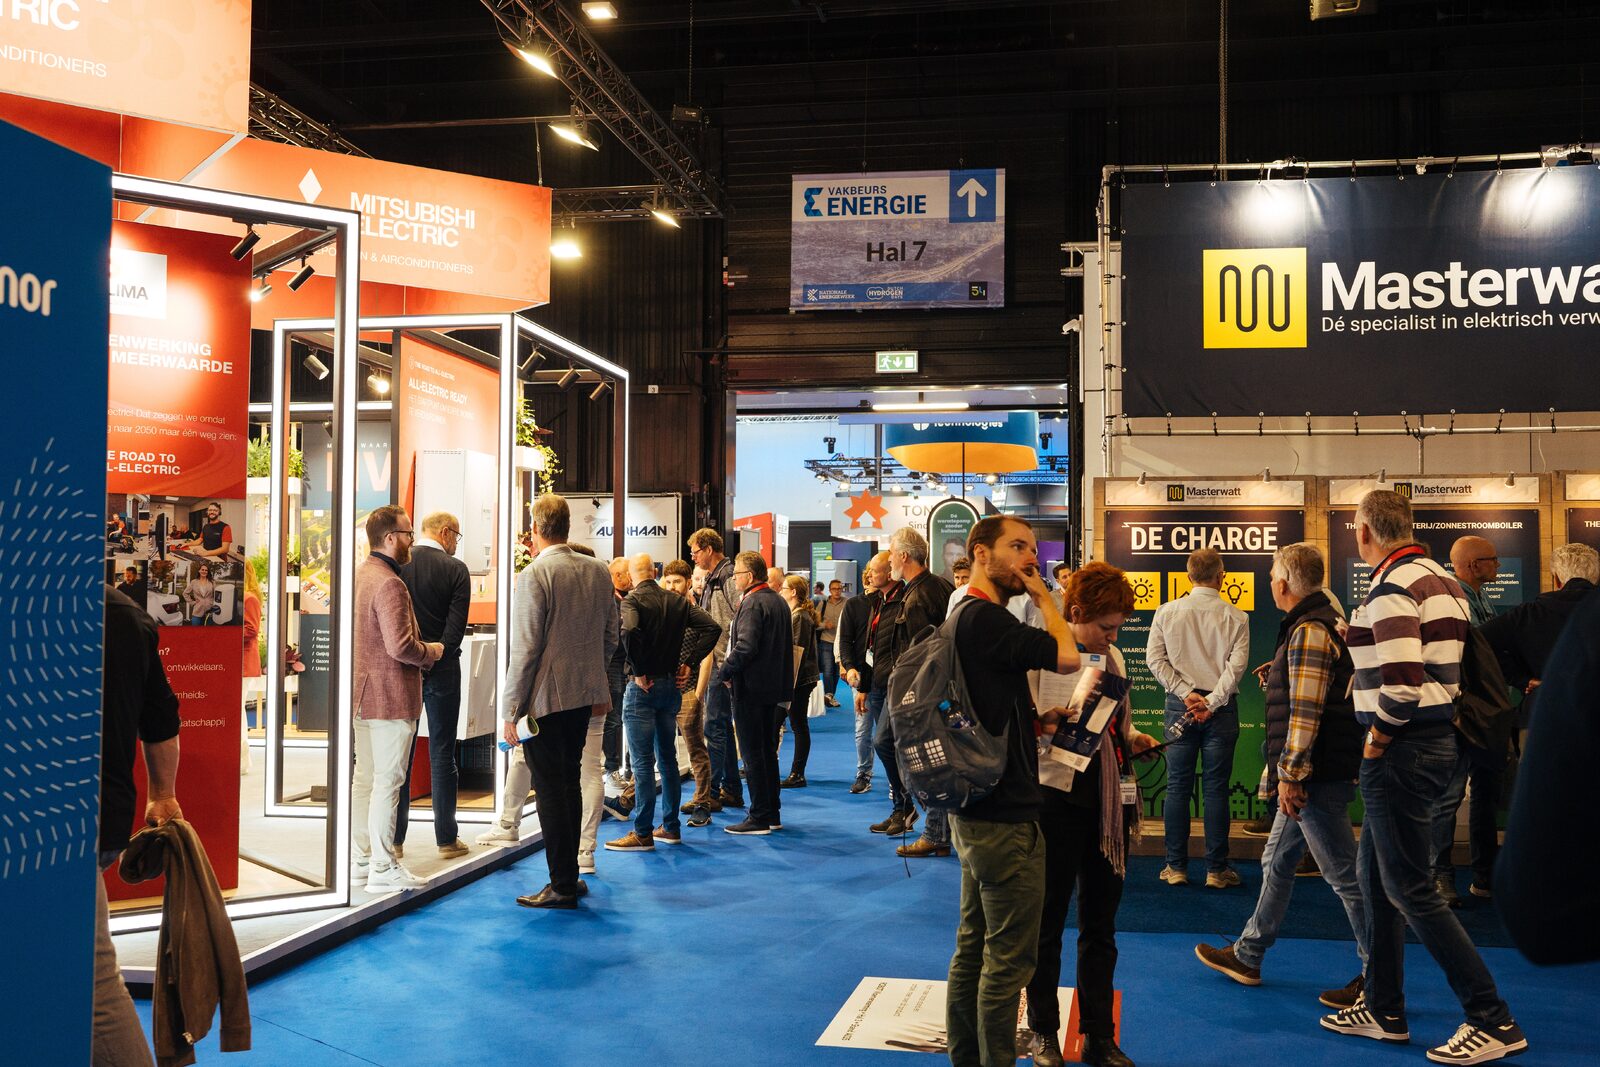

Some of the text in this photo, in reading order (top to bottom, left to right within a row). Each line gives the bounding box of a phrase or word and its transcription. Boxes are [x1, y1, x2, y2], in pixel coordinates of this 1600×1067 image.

[828, 185, 887, 195] VAKBEURS
[350, 191, 475, 229] MITSUBISHI
[827, 195, 926, 216] ENERGIE
[866, 241, 927, 262] Hal 7
[380, 254, 474, 274] AIRCONDITIONERS
[1322, 309, 1600, 335] Dé specialist in elektrisch verw
[109, 334, 211, 356] ENWERKING
[111, 351, 233, 374] MEERWAARDE
[408, 377, 468, 404] ALL-ELECTRIC READY
[152, 412, 183, 422] zeggen
[199, 415, 226, 424] omdat
[114, 425, 132, 433] naar
[135, 425, 157, 434] 2050
[159, 428, 180, 436] maar
[182, 429, 197, 437] één
[199, 431, 217, 440] weg
[219, 431, 237, 440] zien:
[119, 451, 156, 462] ROAD
[159, 453, 176, 463] TO
[1186, 487, 1241, 496] Masterwatt
[1415, 485, 1472, 494] Masterwatt
[596, 525, 667, 536] AUHAAN
[1412, 522, 1523, 530] TERIJ/ZONNESTROOMBOILER
[1584, 520, 1600, 528] THE
[1131, 526, 1278, 550] DE CHARGE
[166, 663, 226, 672] ontwikkelaars,
